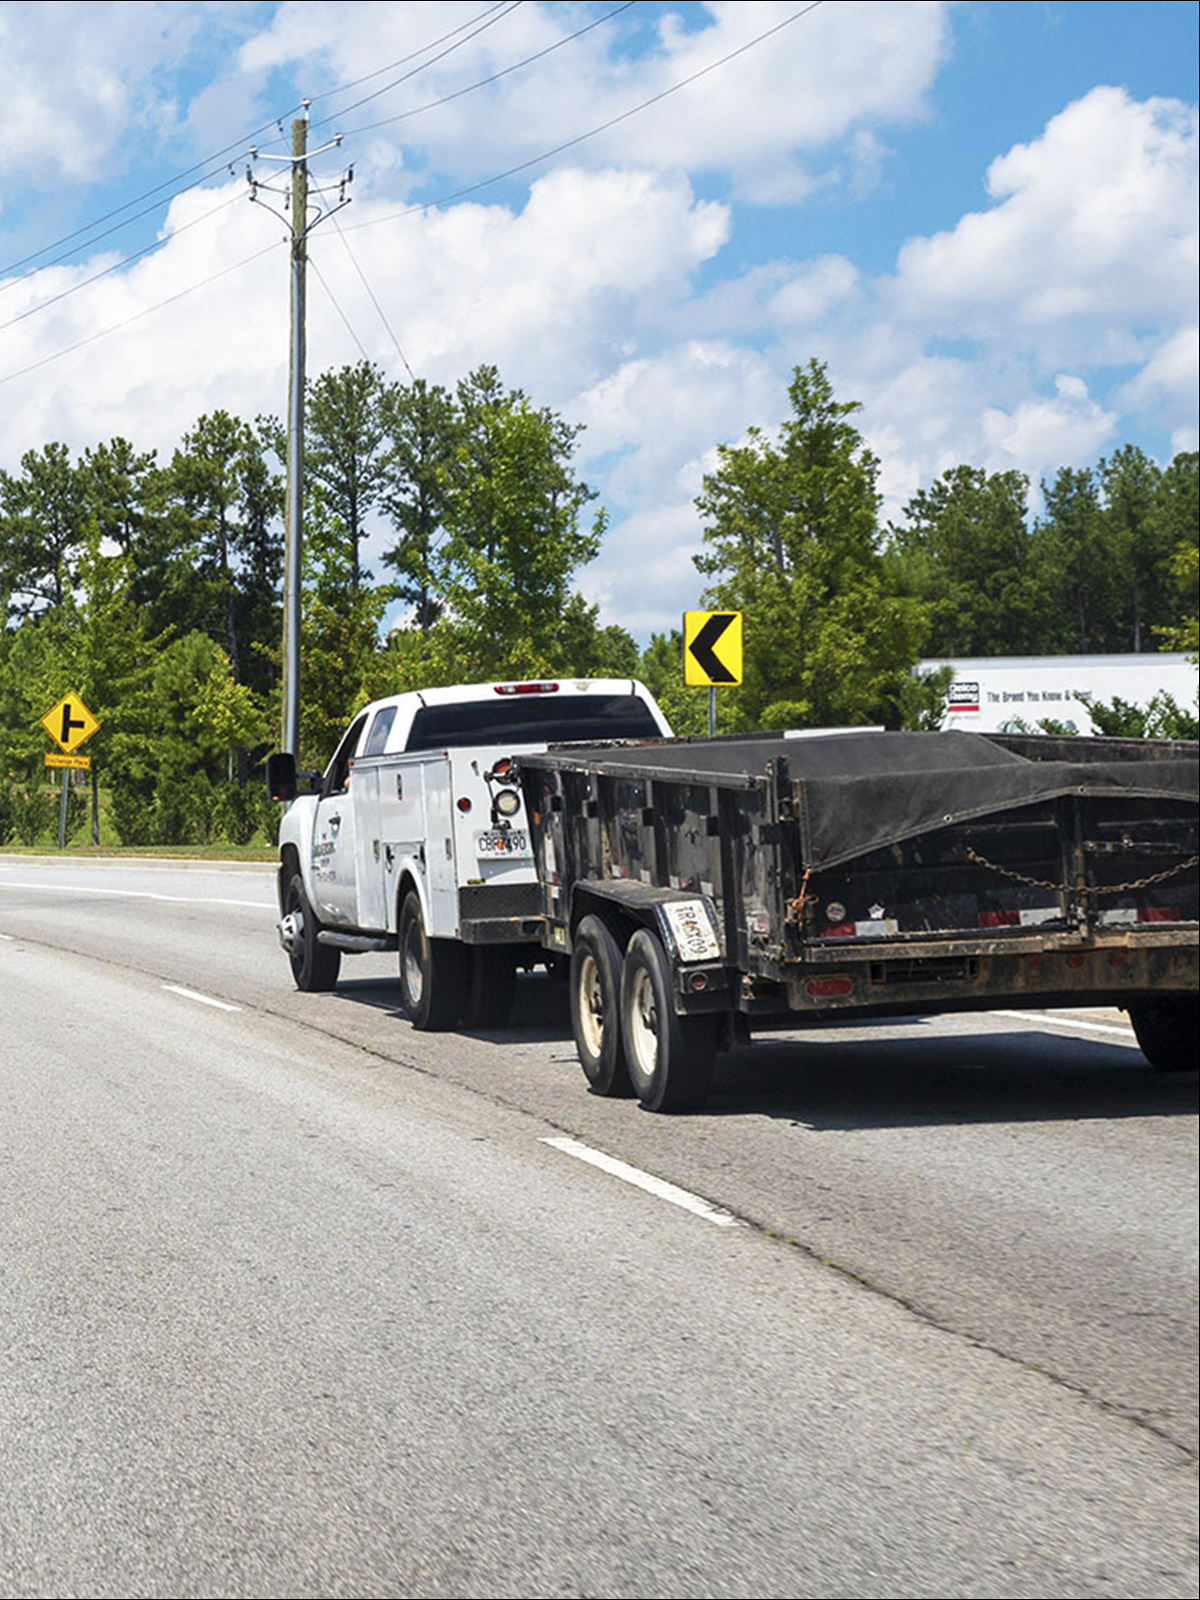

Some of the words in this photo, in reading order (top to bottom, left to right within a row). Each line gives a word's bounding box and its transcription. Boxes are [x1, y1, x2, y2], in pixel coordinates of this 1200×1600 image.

[987, 692, 1000, 703] The
[1002, 691, 1024, 703] Brand
[1027, 691, 1040, 702] You
[1042, 690, 1062, 702] Know
